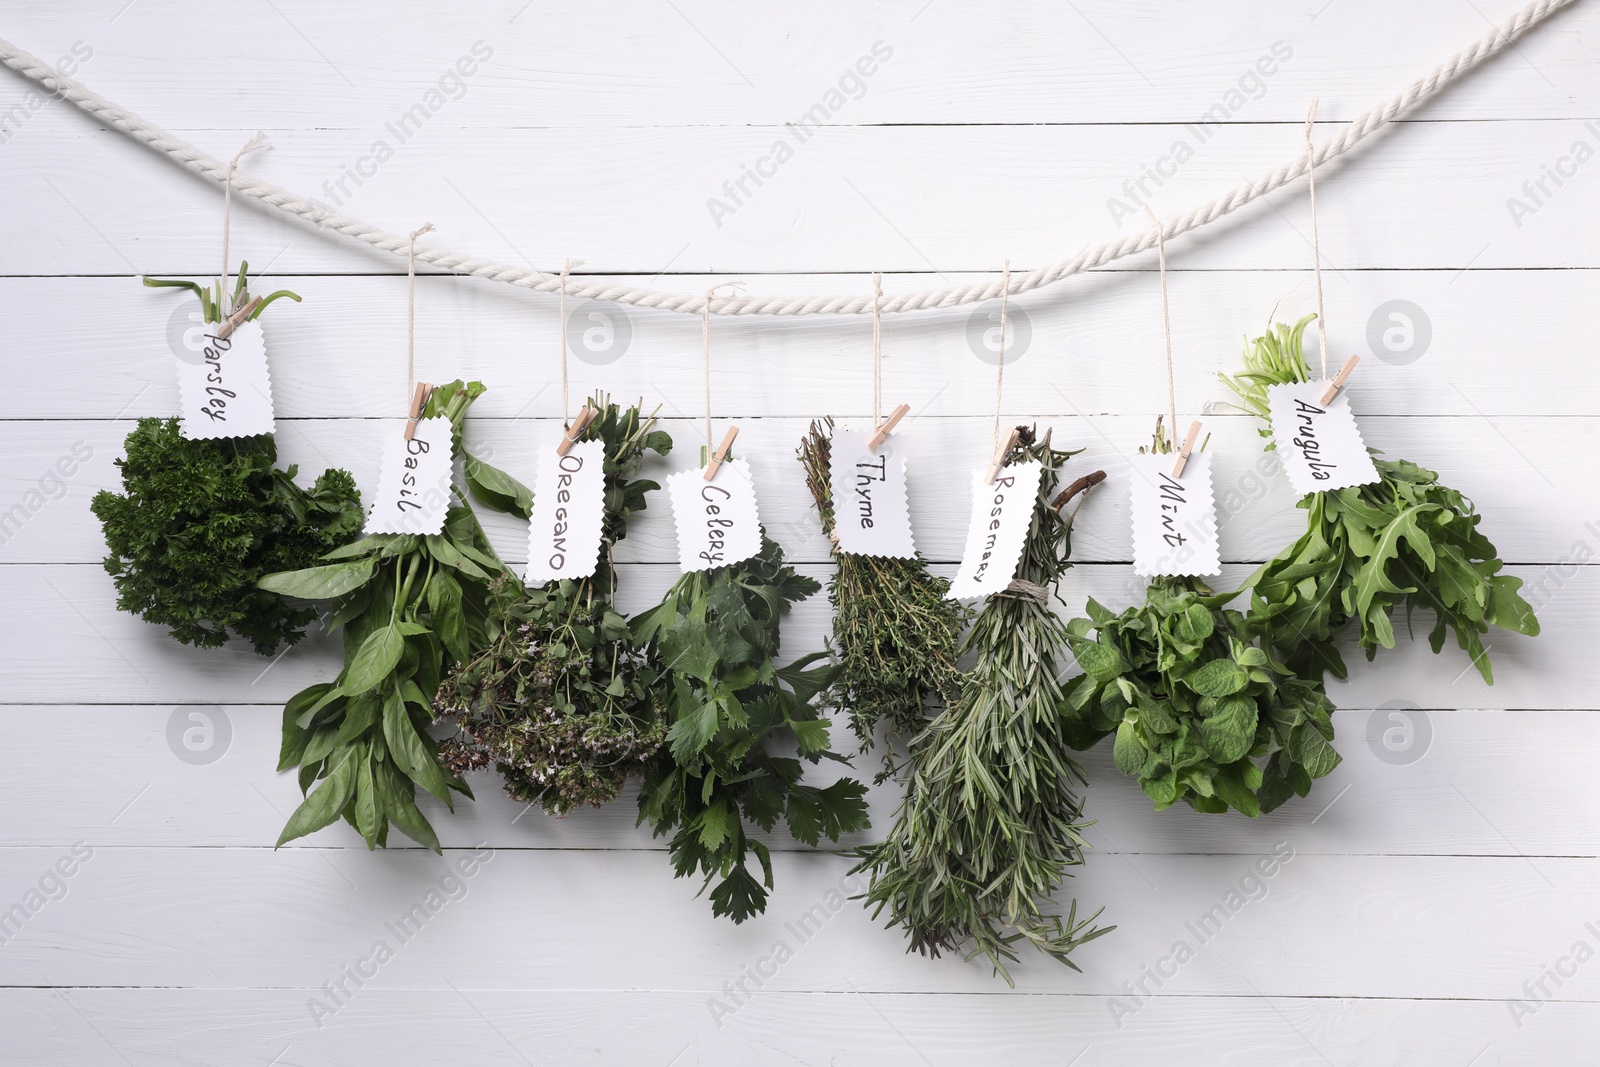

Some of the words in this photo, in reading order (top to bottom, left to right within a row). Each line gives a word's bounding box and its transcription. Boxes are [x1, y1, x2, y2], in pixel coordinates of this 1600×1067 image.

[201, 332, 236, 422] Parsley
[397, 438, 429, 512] Basil
[1293, 398, 1337, 480] Arugula
[855, 454, 885, 529] Thyme
